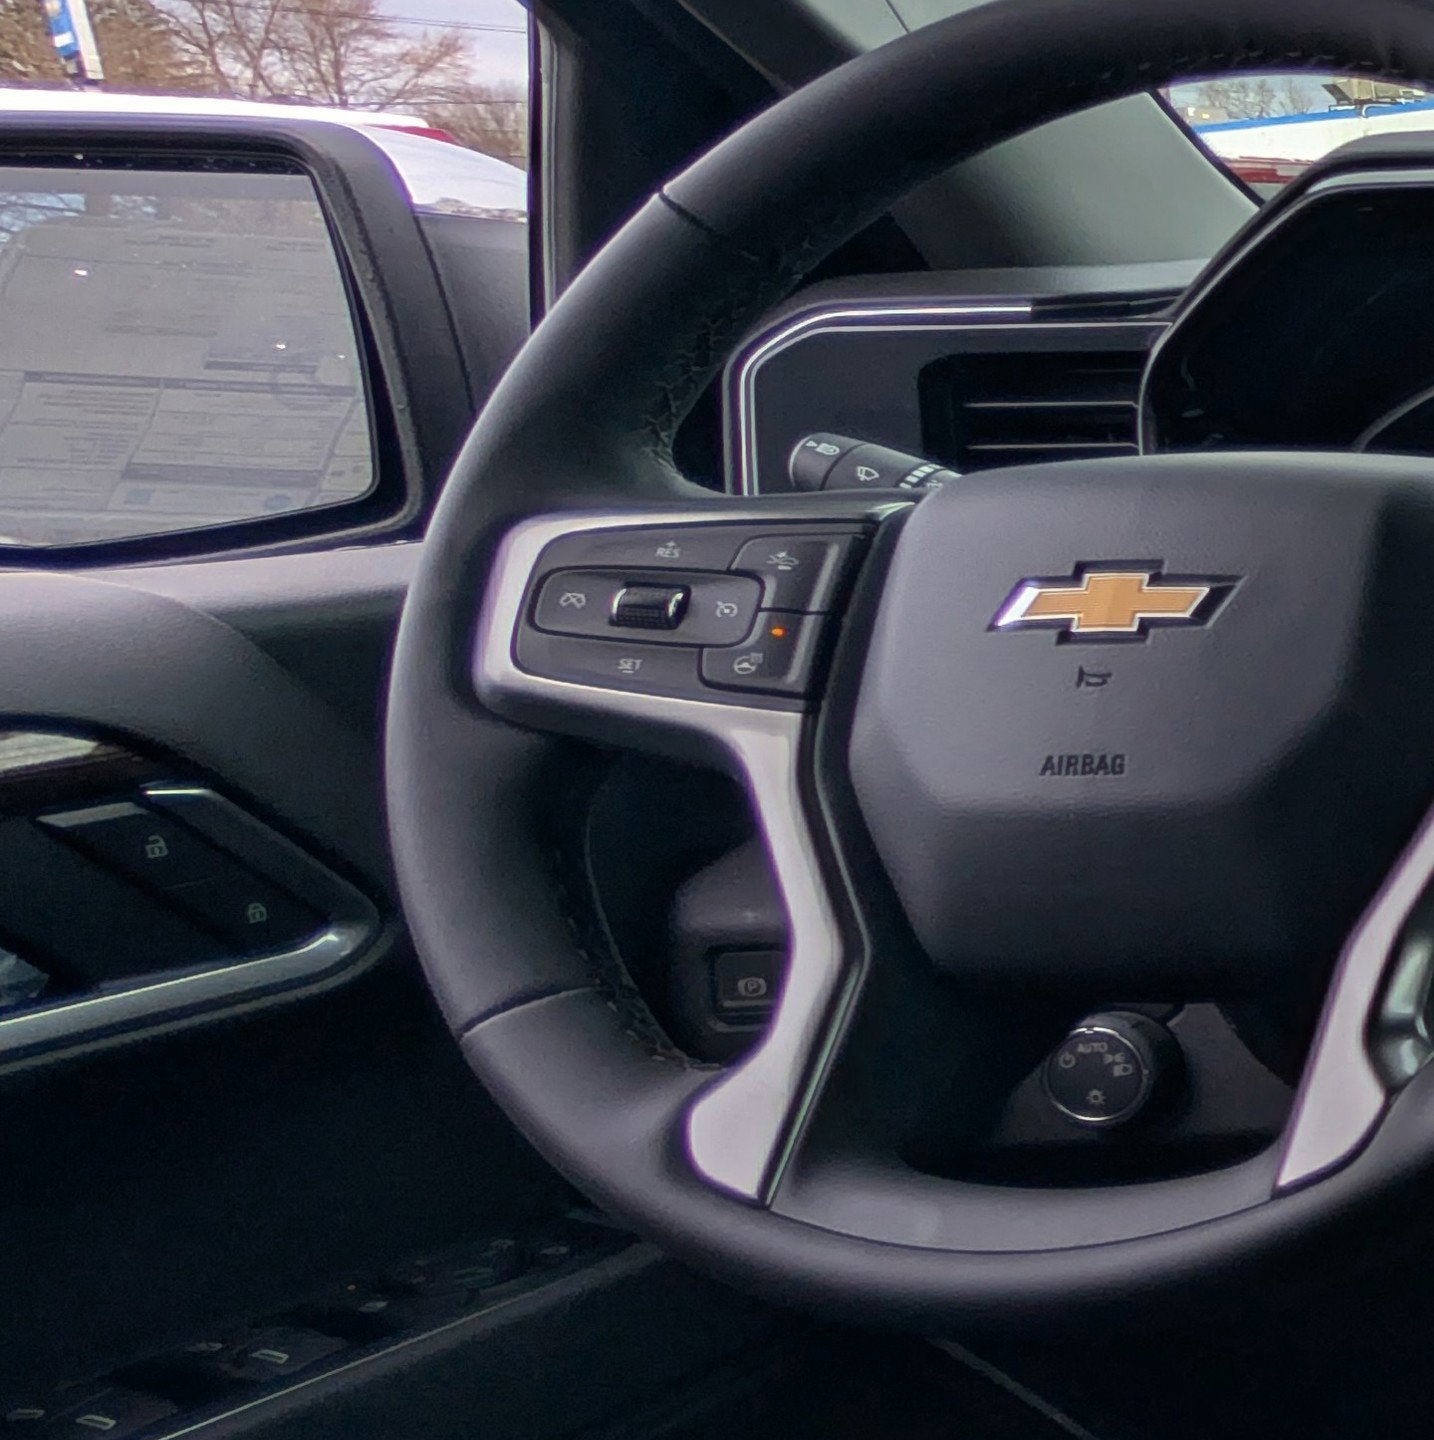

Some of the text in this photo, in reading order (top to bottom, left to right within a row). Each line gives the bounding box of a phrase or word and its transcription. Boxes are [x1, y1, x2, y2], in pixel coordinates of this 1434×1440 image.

[617, 656, 641, 671] SET
[1039, 753, 1126, 776] AIRBAG
[1077, 1042, 1108, 1053] AUTO
